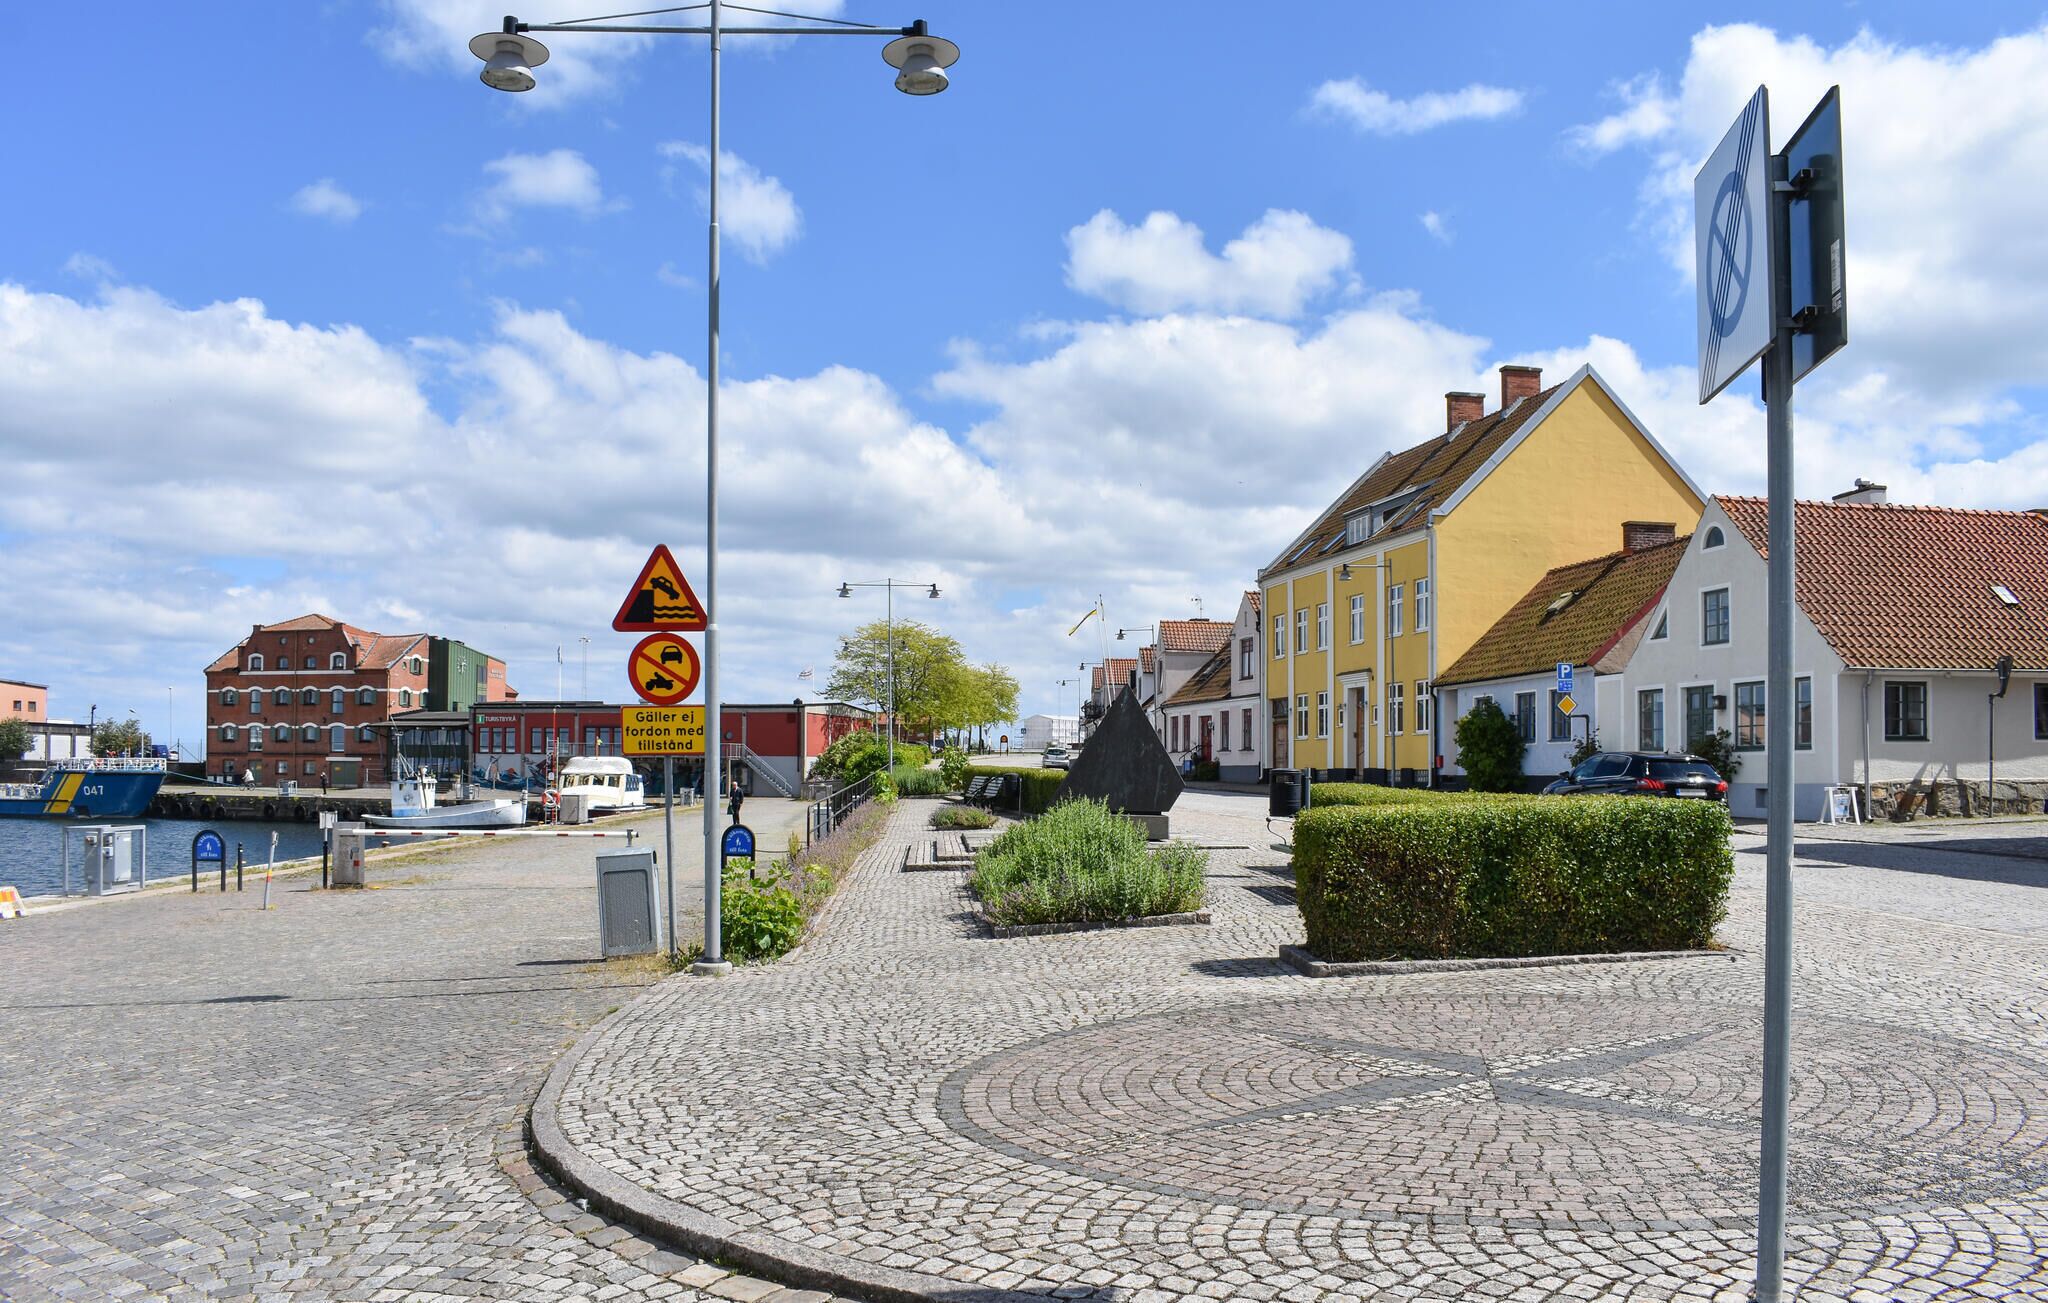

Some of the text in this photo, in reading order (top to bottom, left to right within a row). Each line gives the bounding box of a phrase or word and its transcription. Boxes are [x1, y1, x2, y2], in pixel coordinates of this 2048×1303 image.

[1561, 665, 1570, 678] P
[635, 711, 694, 724] Gäller ej
[625, 725, 704, 737] fordon med
[638, 739, 693, 751] tillstånd
[83, 785, 104, 796] 047
